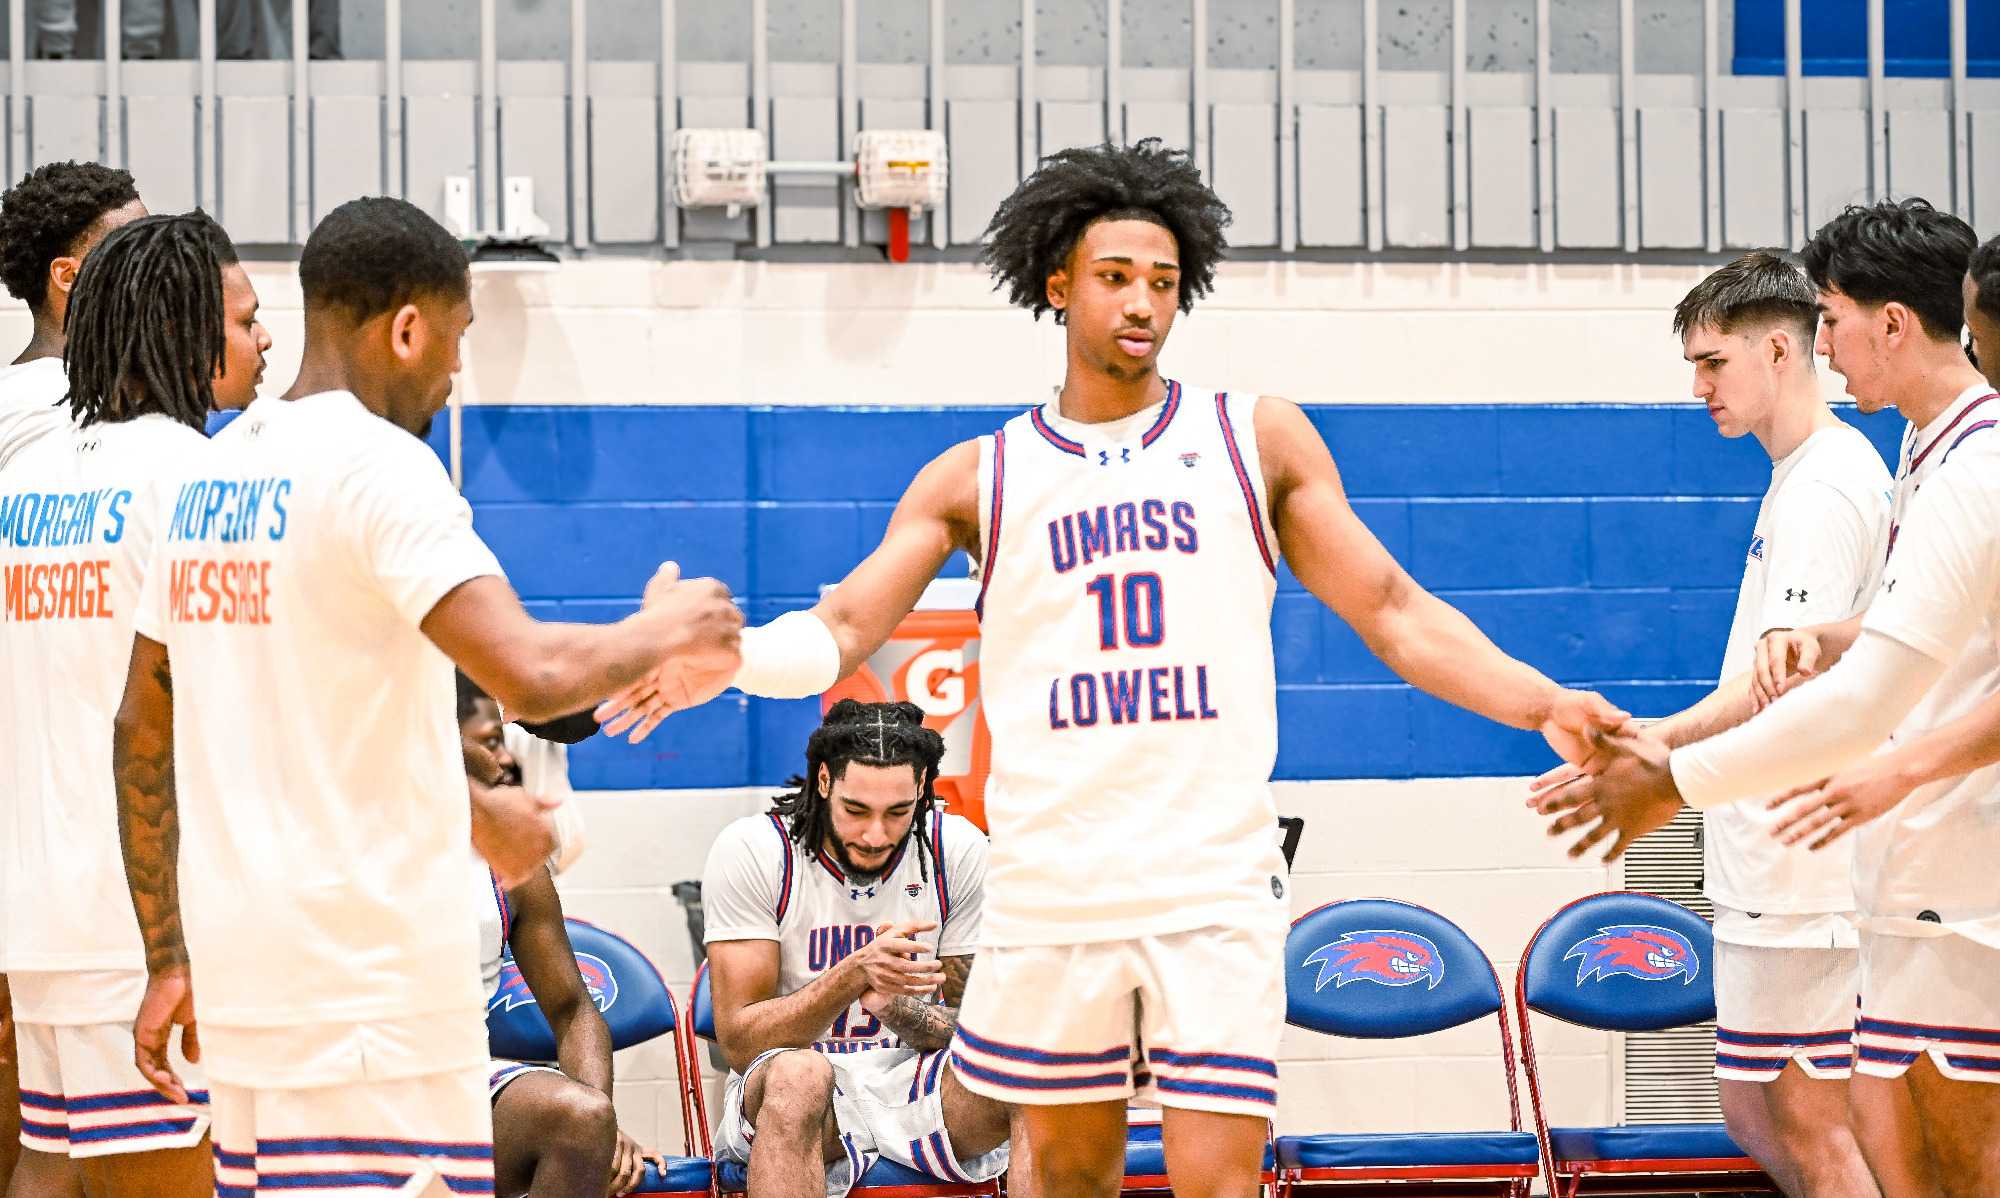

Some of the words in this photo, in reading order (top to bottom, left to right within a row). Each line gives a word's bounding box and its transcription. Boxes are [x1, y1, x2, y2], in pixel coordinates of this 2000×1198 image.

[0, 487, 133, 548] MORGAN'S
[168, 477, 291, 543] MORGAN'S
[1048, 499, 1198, 574] UMASS
[4, 560, 114, 622] MESSAGE
[169, 559, 272, 625] MESSAGE
[1086, 571, 1165, 651] 10
[906, 648, 965, 717] G
[1049, 665, 1218, 730] LOWELL
